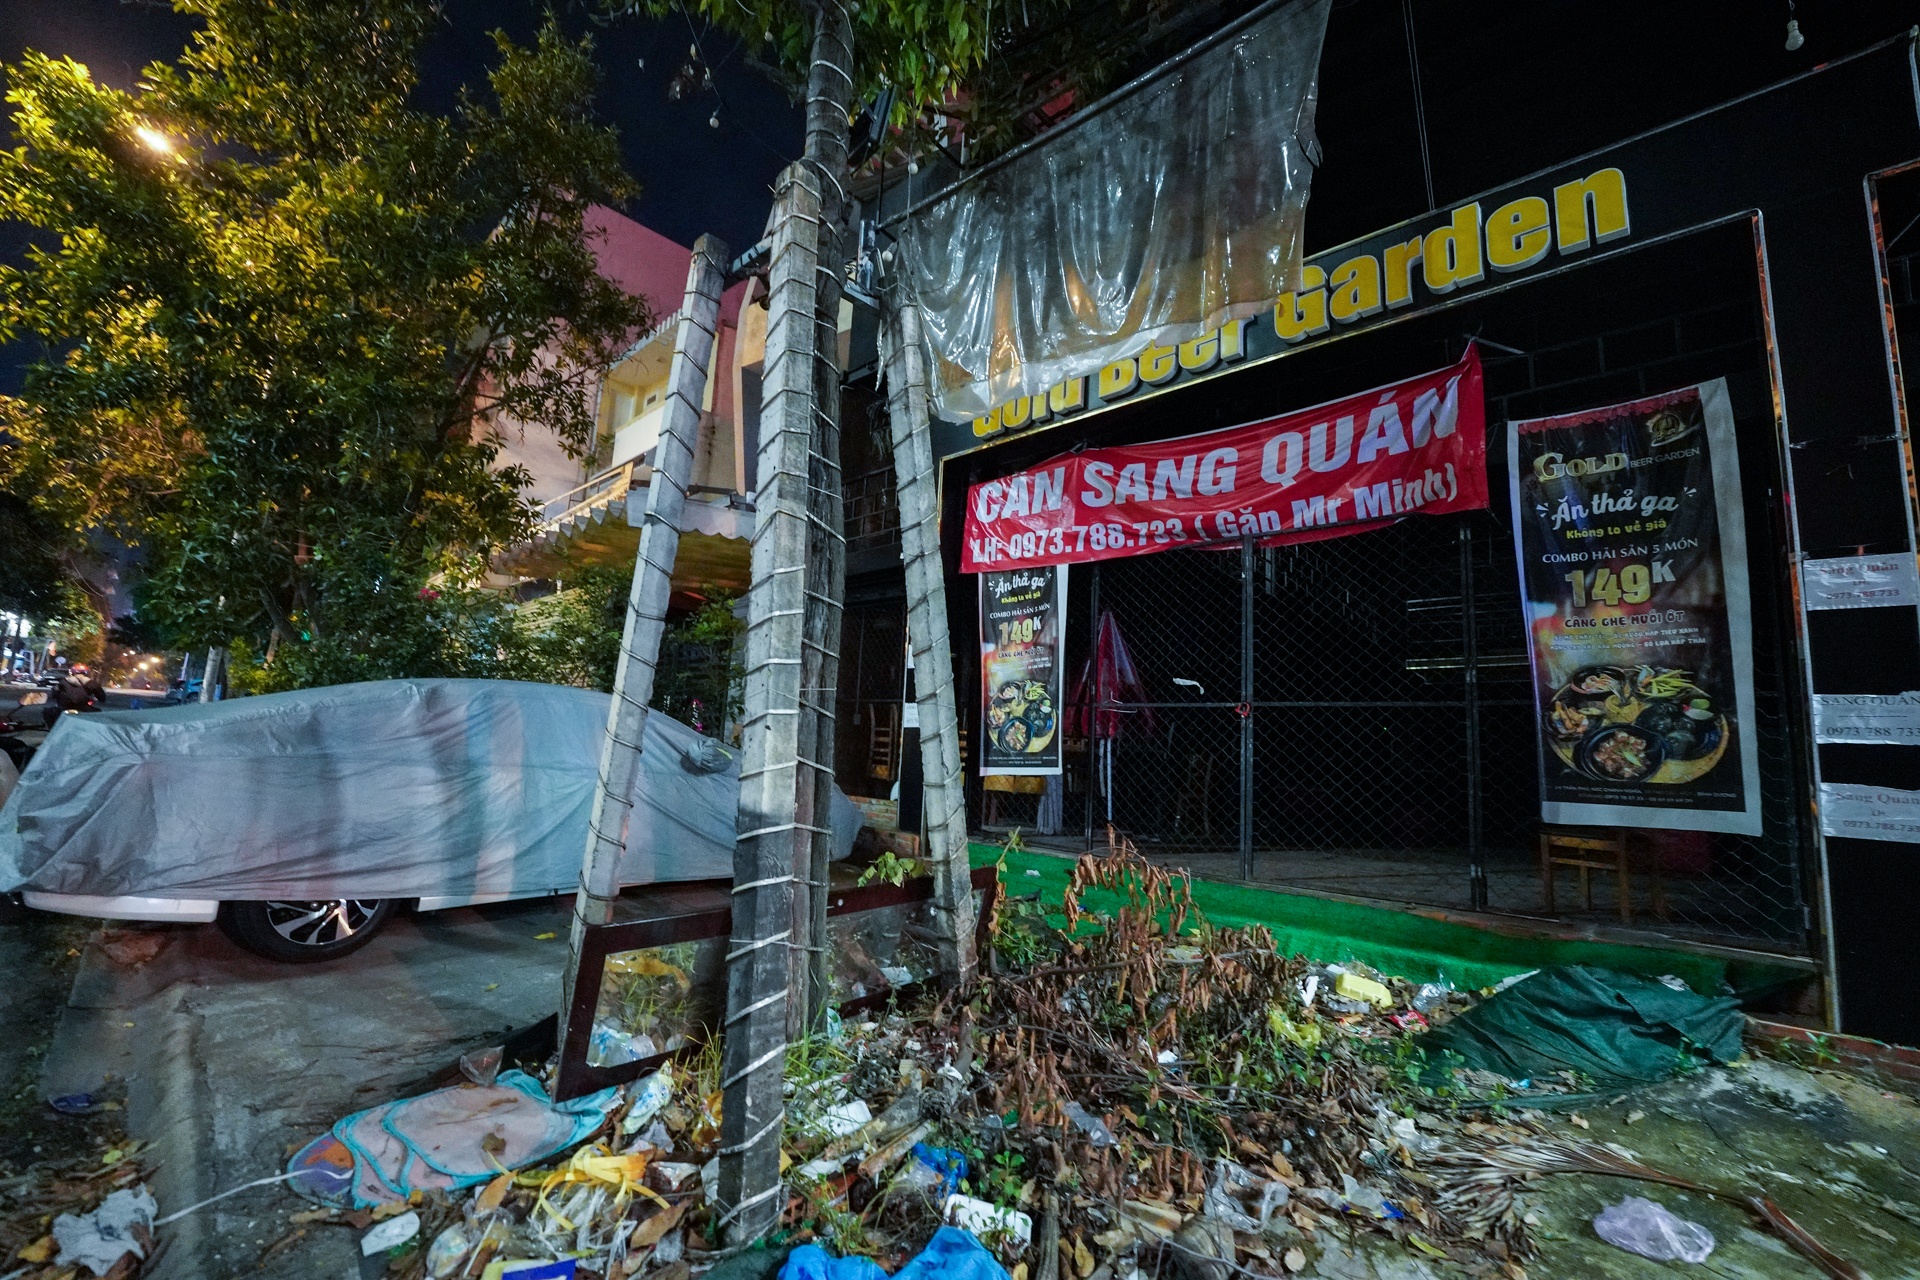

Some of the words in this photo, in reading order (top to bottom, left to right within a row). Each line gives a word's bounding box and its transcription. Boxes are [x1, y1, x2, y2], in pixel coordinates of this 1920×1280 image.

[1274, 168, 1630, 344] Garden
[1081, 446, 1239, 509] SANG
[1261, 374, 1463, 487] QUÁN
[1533, 452, 1628, 482] GOLD
[1630, 456, 1653, 469] BEER
[1655, 447, 1700, 463] GARDEN
[1291, 495, 1342, 529] Mr
[1354, 462, 1458, 520] Minh)
[1551, 496, 1589, 530] Ăn
[1591, 488, 1638, 515] thả
[1640, 495, 1679, 516] ga
[1542, 551, 1589, 563] COMBO
[1652, 543, 1660, 554] 5
[1664, 537, 1698, 551] MÓN
[1566, 526, 1604, 539] Không
[995, 576, 1012, 598] Ăn
[1012, 572, 1030, 588] thả
[1031, 576, 1045, 590] ga
[990, 611, 1010, 619] COMBO
